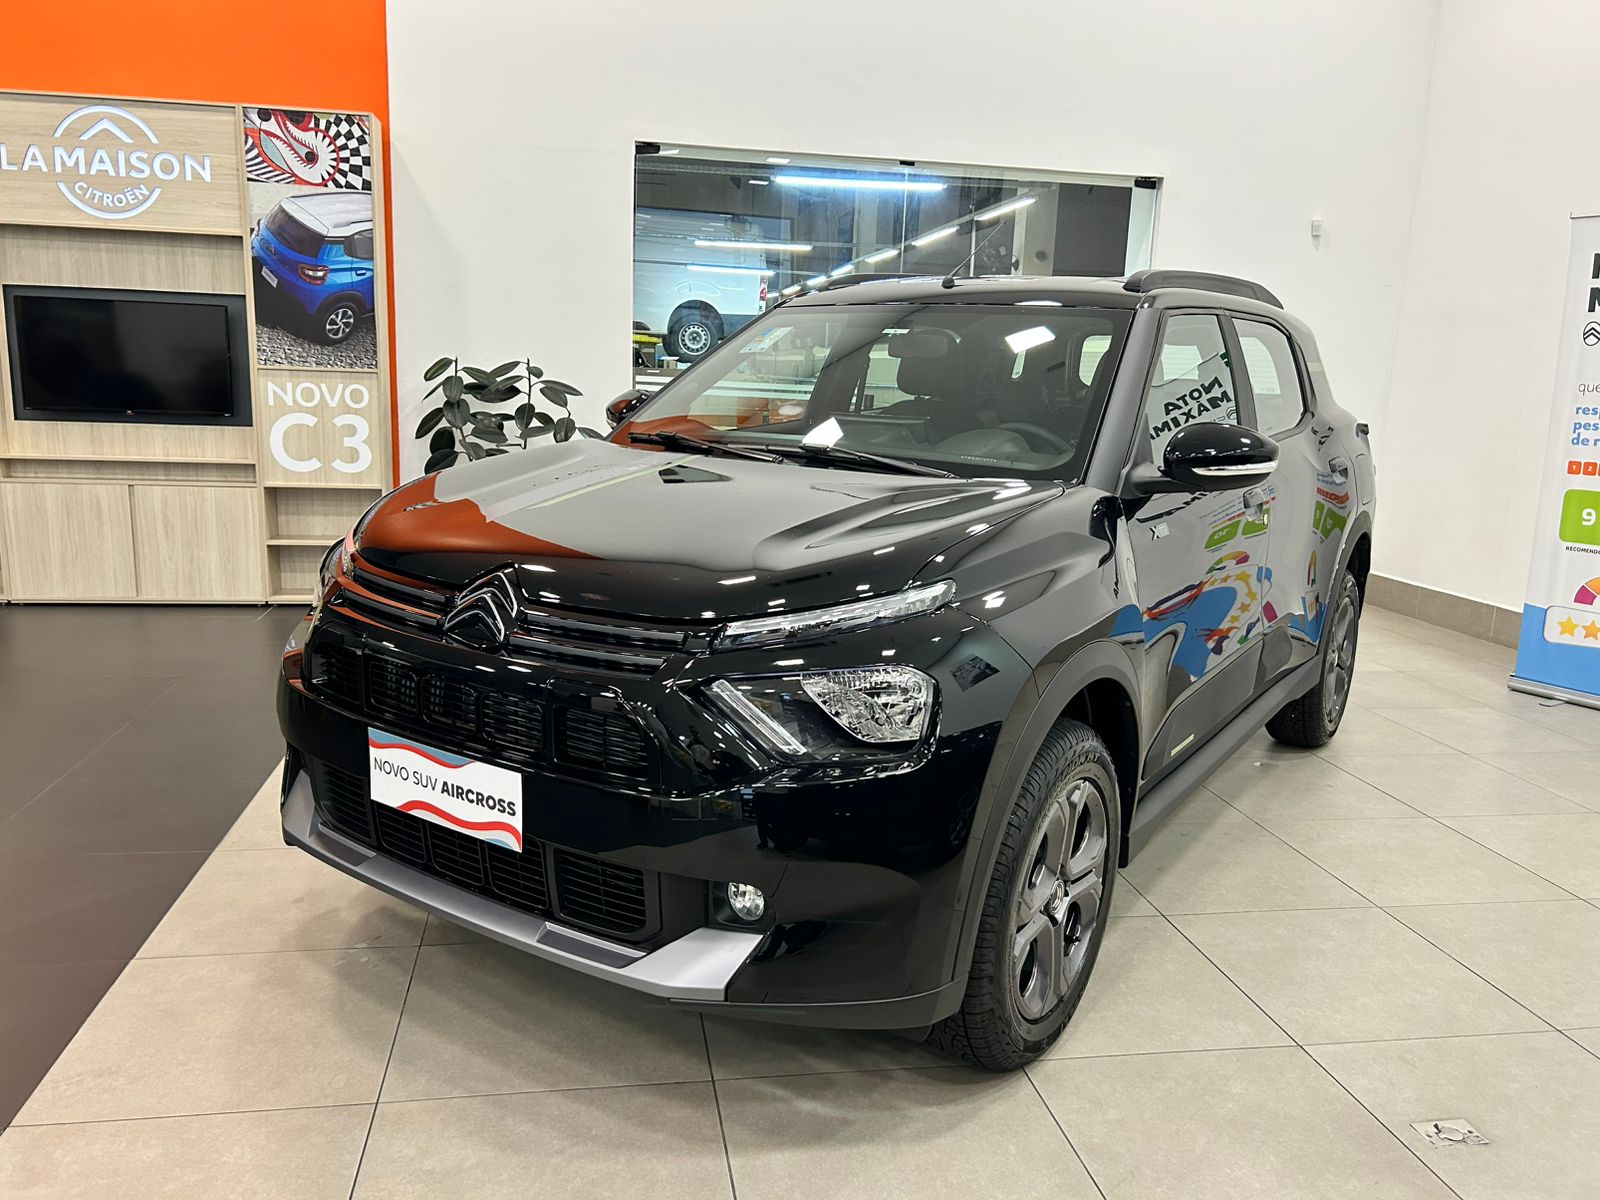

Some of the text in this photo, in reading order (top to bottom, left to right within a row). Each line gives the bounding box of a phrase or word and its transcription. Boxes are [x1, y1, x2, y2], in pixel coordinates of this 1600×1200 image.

[74, 181, 150, 207] CITROËN
[267, 381, 370, 409] NOVO
[1575, 406, 1600, 420] res
[269, 412, 372, 473] C3
[1571, 432, 1590, 447] de
[1581, 508, 1597, 526] 9
[374, 757, 516, 817] NOVO SUV AIRCROSS
